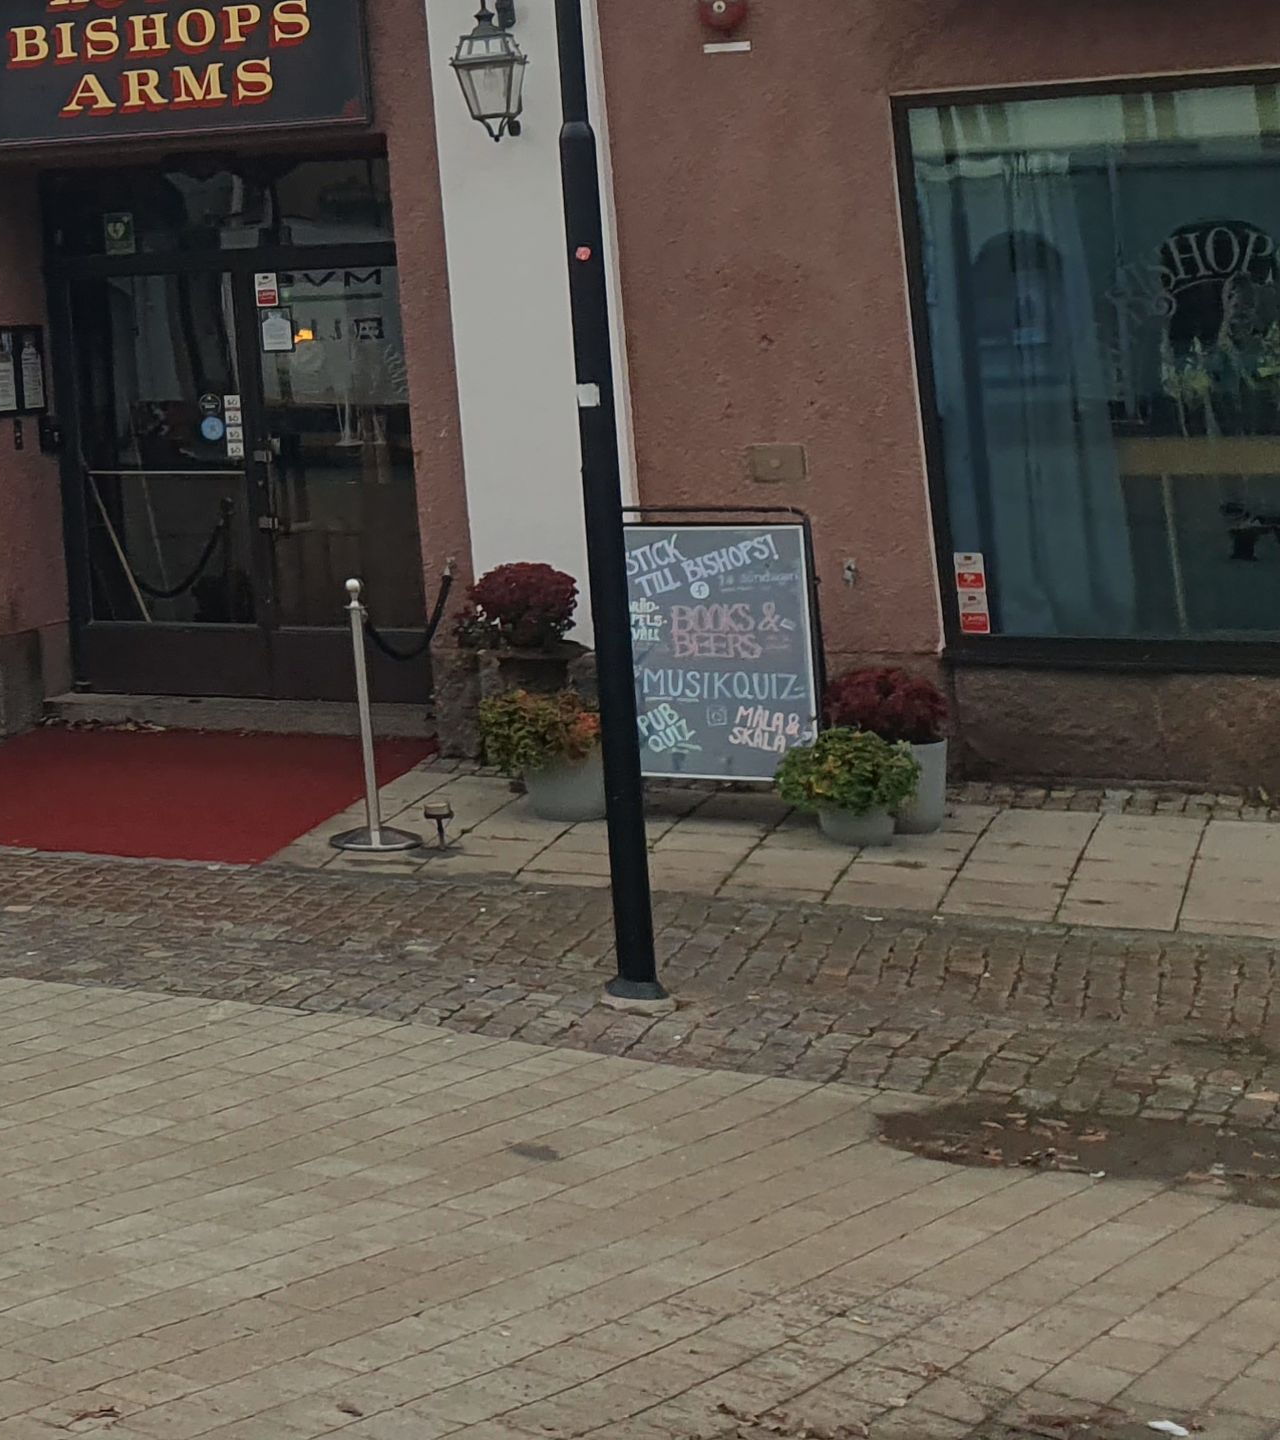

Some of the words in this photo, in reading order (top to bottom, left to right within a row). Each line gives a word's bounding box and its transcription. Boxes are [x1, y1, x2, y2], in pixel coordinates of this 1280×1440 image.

[61, 56, 275, 116] ARMS
[626, 533, 688, 577] STICK
[635, 567, 682, 599] TILL
[680, 533, 780, 584] BISHOPS!
[670, 603, 755, 634] BOOKS
[757, 601, 781, 632] &
[672, 632, 763, 659] BEERS
[642, 667, 805, 701] MUSIKQUIZ
[637, 702, 680, 737] PUB
[648, 718, 697, 753] QUIZ
